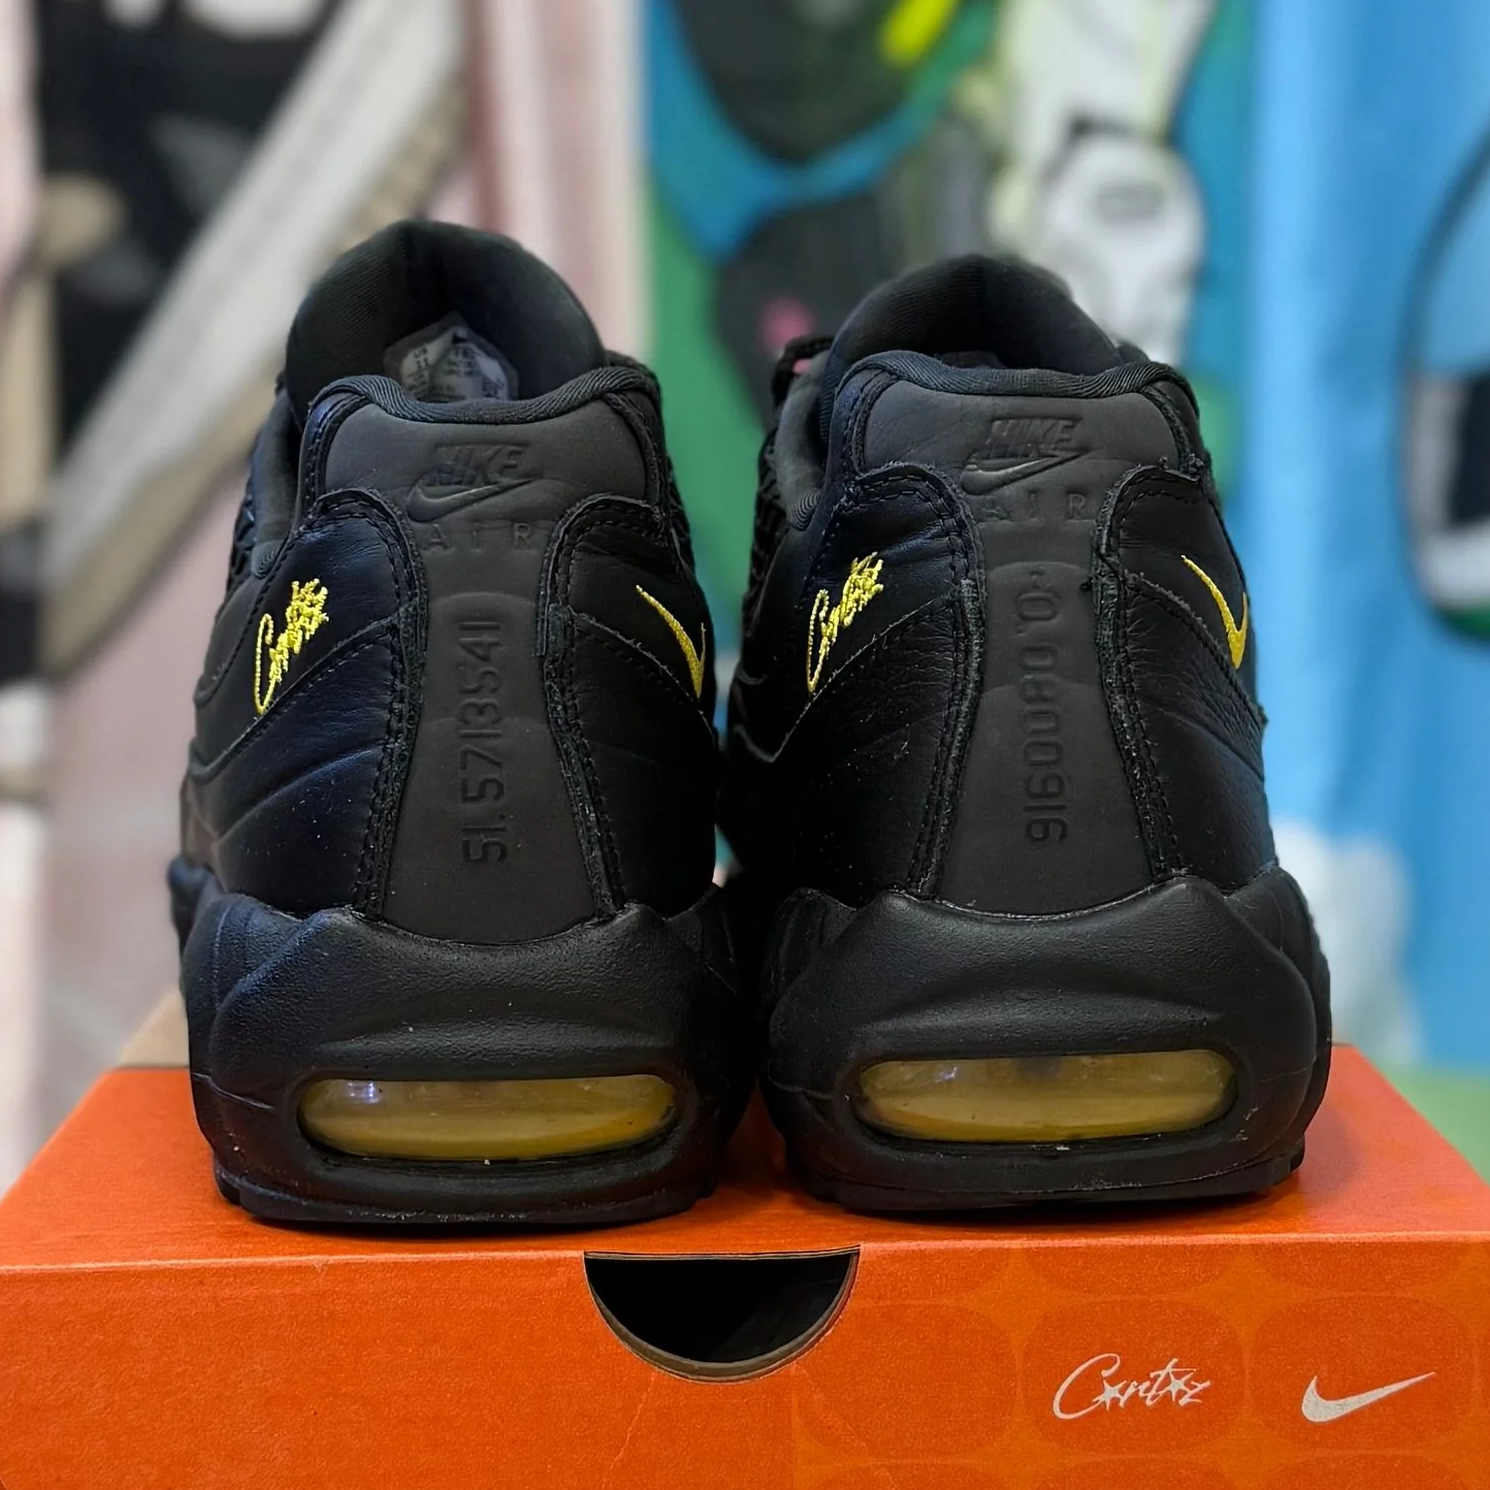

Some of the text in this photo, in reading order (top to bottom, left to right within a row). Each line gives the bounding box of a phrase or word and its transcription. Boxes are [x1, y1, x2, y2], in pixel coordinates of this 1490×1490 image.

[981, 420, 1076, 459] NIKE
[426, 445, 526, 487] NIKE
[420, 523, 533, 553] AIR
